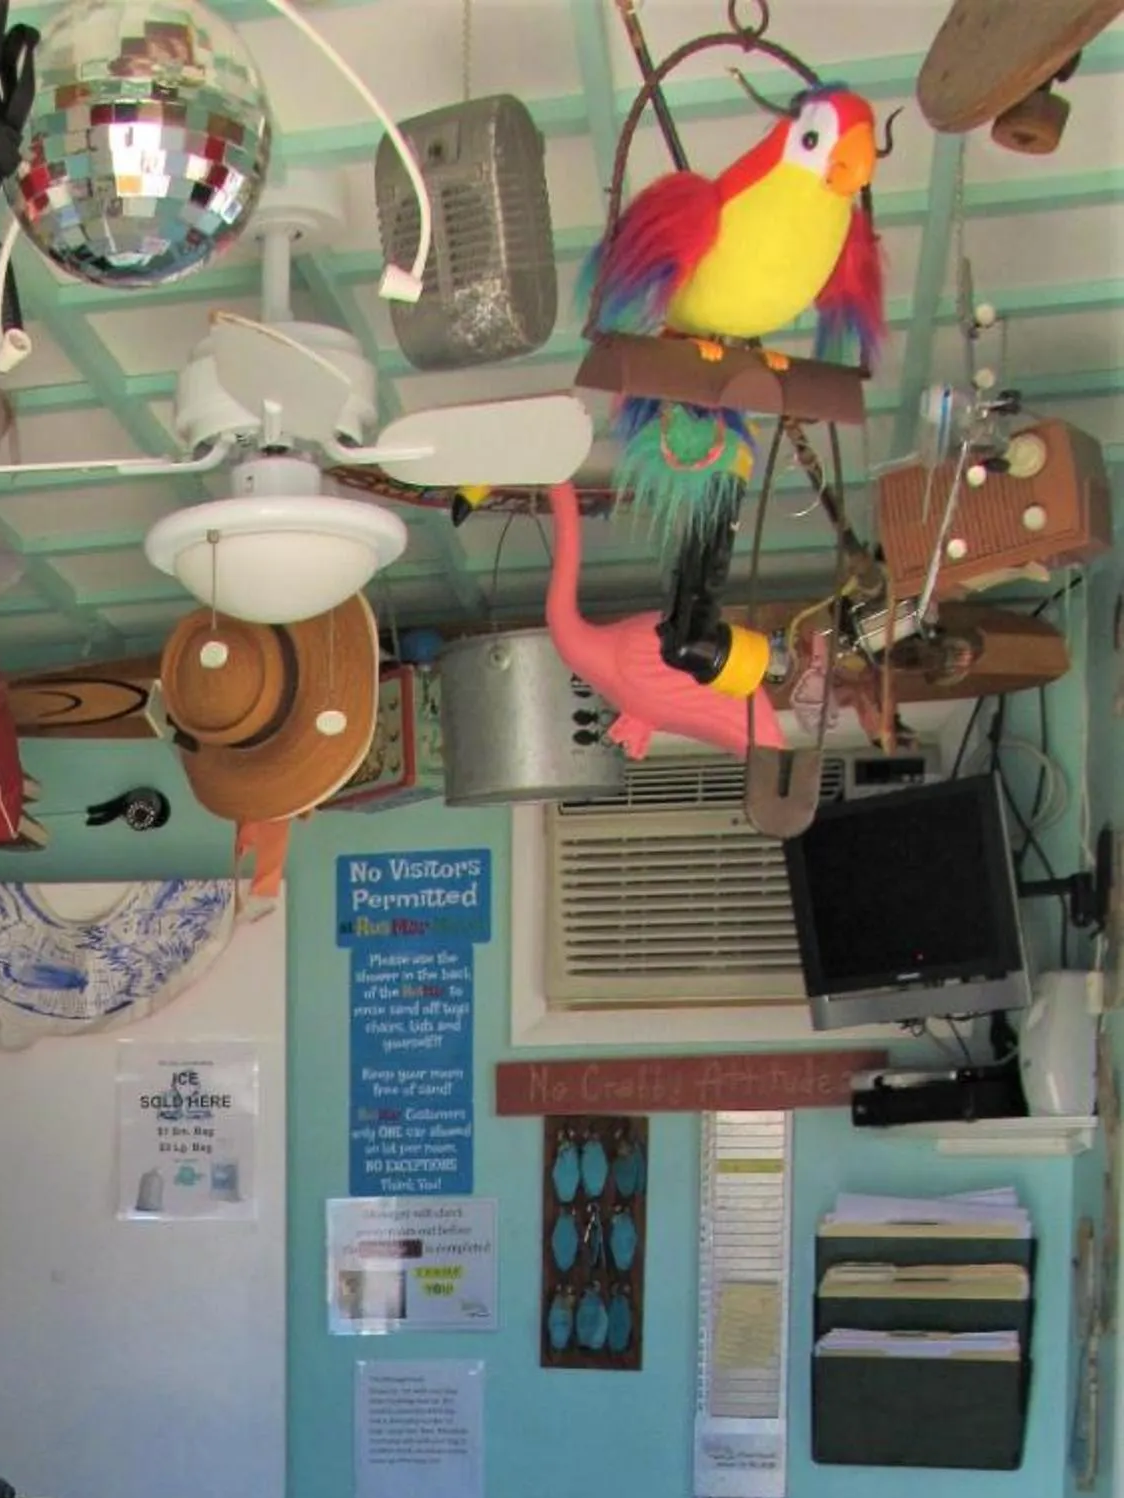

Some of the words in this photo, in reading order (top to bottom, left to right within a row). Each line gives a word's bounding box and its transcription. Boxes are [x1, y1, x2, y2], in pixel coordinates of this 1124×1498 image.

[349, 862, 382, 883] No
[388, 858, 482, 881] Visitors
[352, 882, 478, 911] Permitted
[370, 953, 410, 968] Please
[412, 954, 434, 966] use
[438, 950, 459, 965] the
[417, 966, 439, 981] the
[442, 966, 472, 980] back
[364, 986, 377, 999] of
[379, 985, 400, 998] the
[449, 985, 464, 998] to
[390, 1001, 420, 1016] sand
[422, 1001, 441, 1016] off
[438, 1018, 462, 1032] and
[171, 1071, 200, 1087] ICE
[362, 1068, 394, 1083] Keep
[529, 1065, 564, 1102] No
[140, 1095, 184, 1110] SOLD
[188, 1094, 232, 1109] HERE
[366, 1159, 383, 1173] NO
[386, 1158, 458, 1172] EXCEPTIONS
[381, 1178, 417, 1192] Thank
